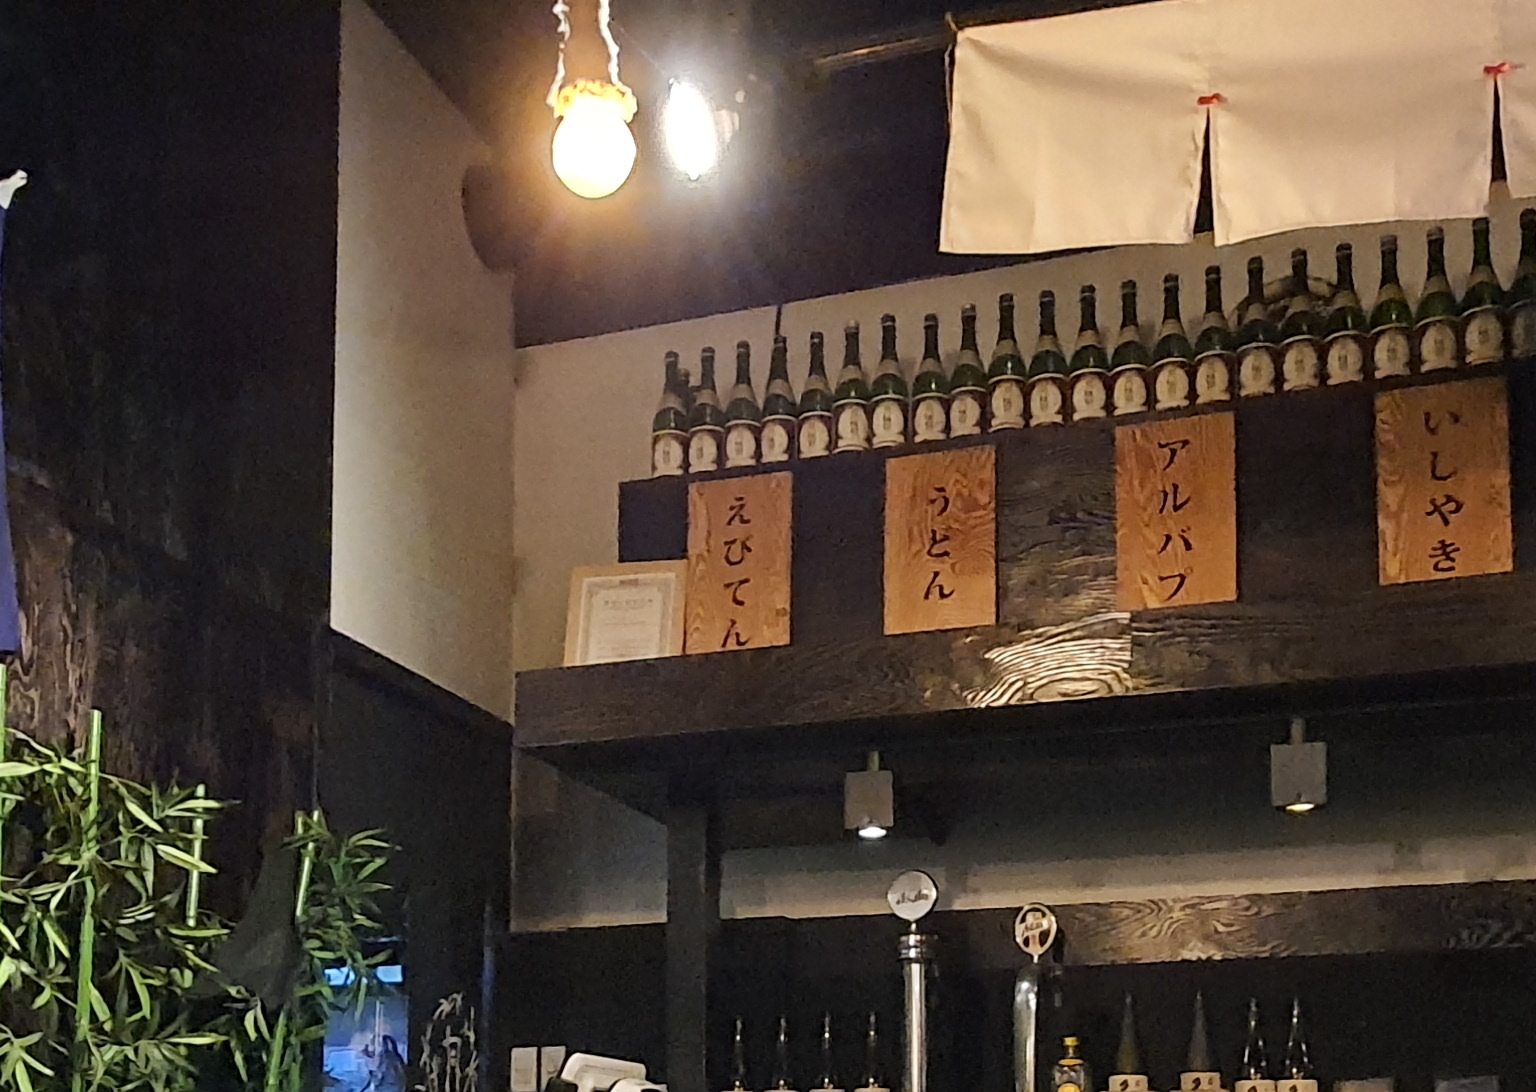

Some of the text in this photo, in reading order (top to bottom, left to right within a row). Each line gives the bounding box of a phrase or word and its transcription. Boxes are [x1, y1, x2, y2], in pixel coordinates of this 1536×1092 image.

[1421, 407, 1466, 574] いしやき
[718, 495, 754, 649] えびてん
